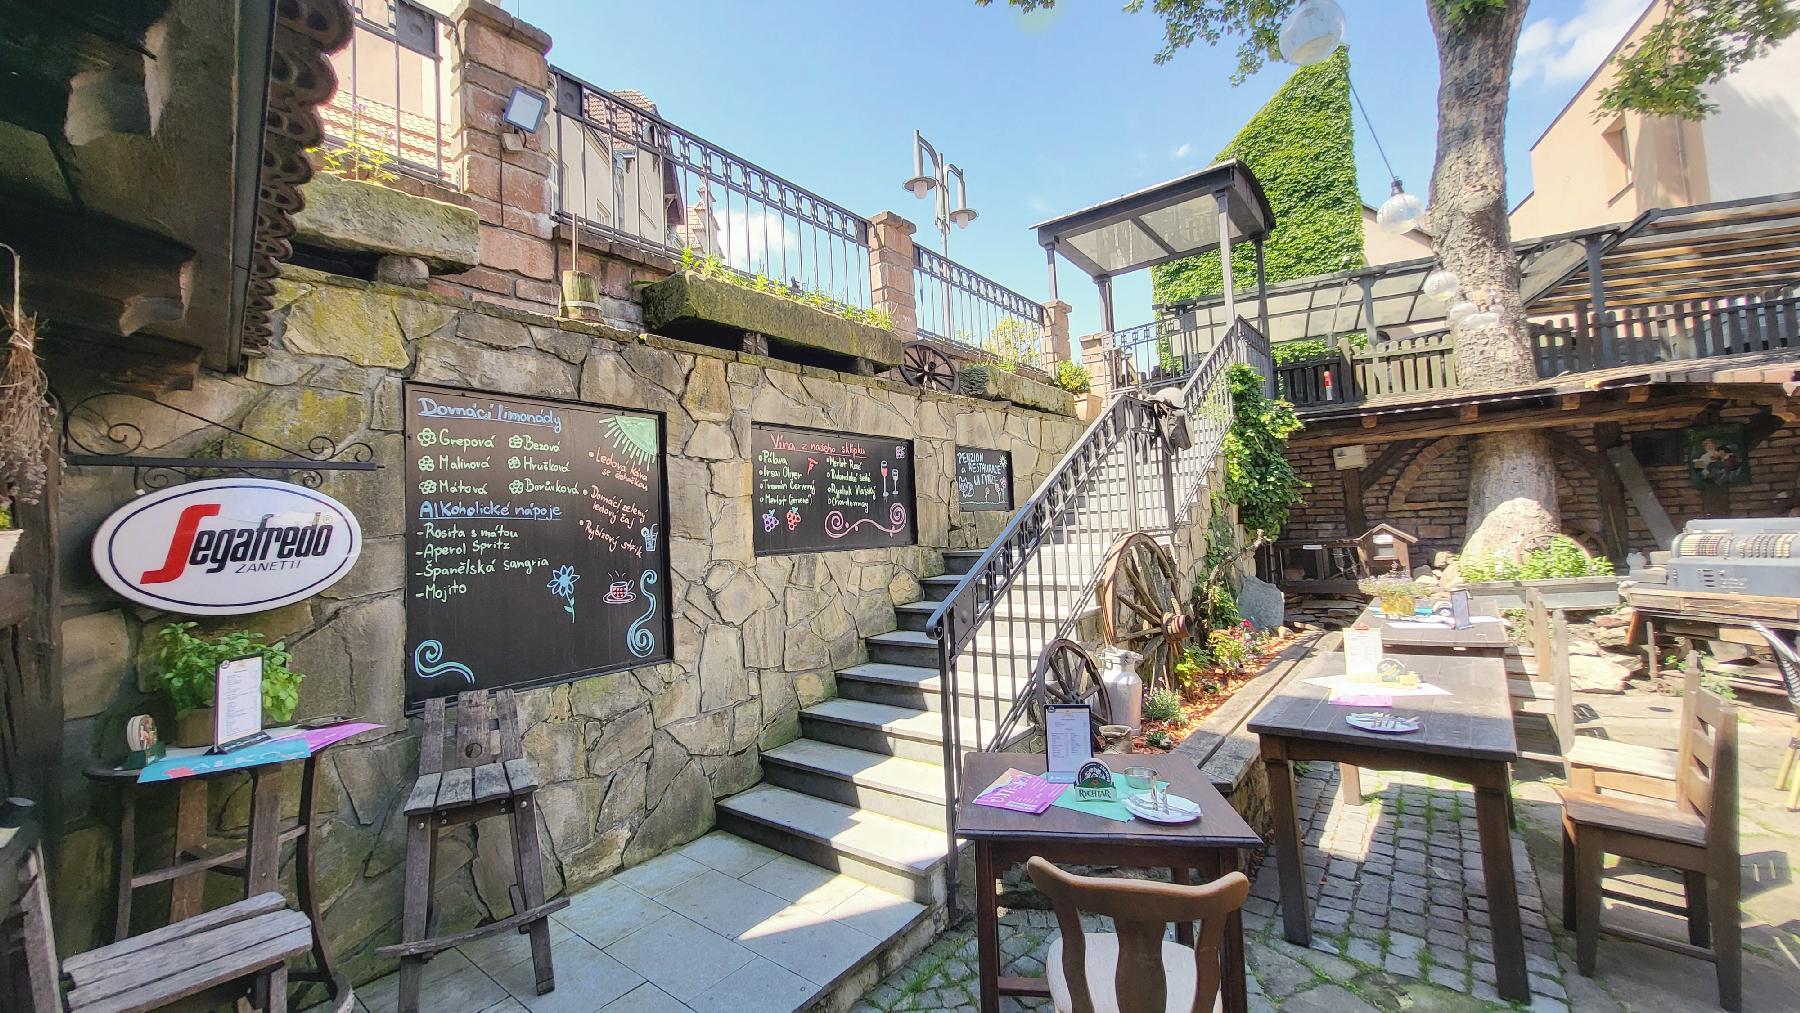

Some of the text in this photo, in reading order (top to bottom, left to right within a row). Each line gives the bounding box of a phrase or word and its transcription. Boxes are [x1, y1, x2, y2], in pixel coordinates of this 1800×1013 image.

[418, 398, 562, 433] Domácí limonády
[439, 429, 497, 452] Grepová
[523, 435, 561, 452] Bezová
[770, 433, 795, 450] Vína
[439, 455, 491, 470] Malinová
[523, 457, 571, 473] Hrušková
[596, 447, 629, 472] Ledová
[957, 452, 984, 464] PENZION
[601, 468, 611, 476] se
[439, 480, 488, 495] Mátová
[524, 478, 580, 495] Borůvková
[515, 501, 562, 521] nápoje
[591, 485, 648, 523] Domácí zelený
[593, 501, 634, 529] ledový čaj
[471, 530, 477, 538] s
[481, 524, 518, 539] mátou
[140, 504, 333, 584] Segafredo
[472, 539, 510, 552] Spritz
[235, 560, 301, 574] ZANETTI
[504, 558, 549, 574] sangria
